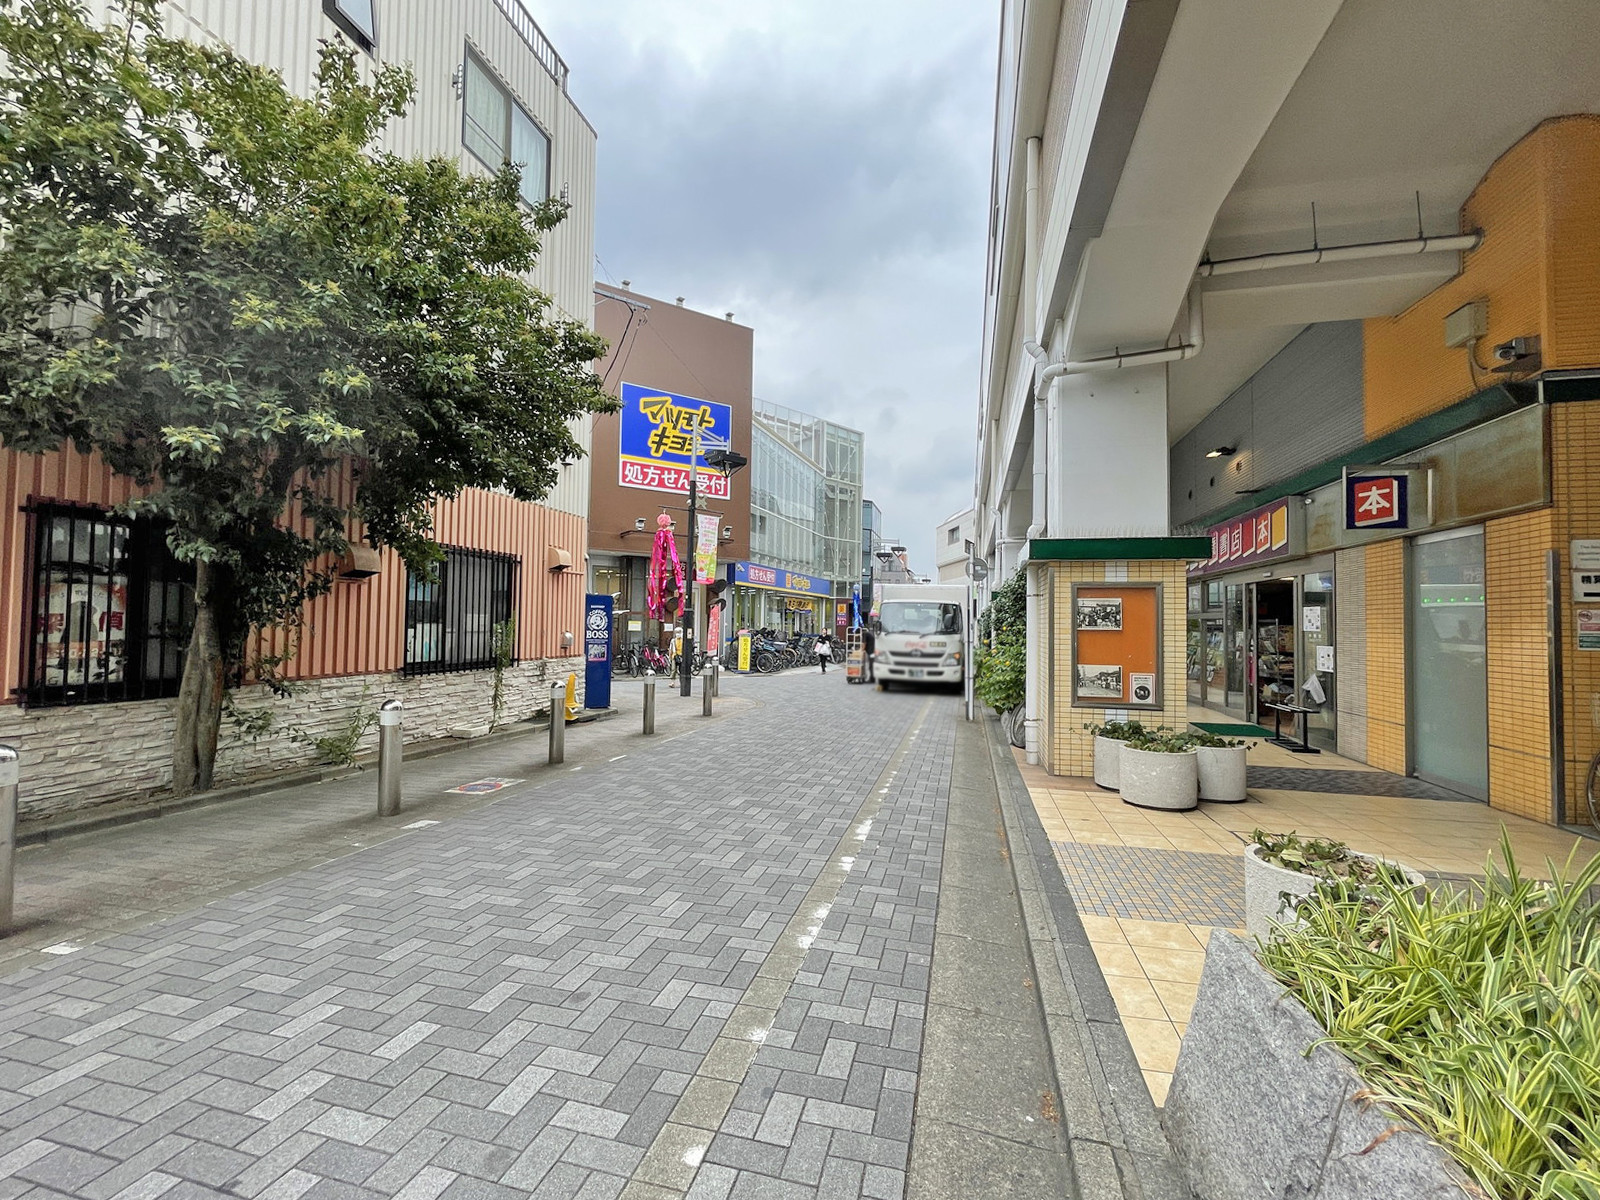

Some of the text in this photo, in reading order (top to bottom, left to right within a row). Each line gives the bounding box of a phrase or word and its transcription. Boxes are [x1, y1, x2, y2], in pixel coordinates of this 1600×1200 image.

[641, 398, 714, 432] マツモト
[624, 463, 727, 495] 処方せん受付
[1358, 485, 1390, 515] 本
[1257, 518, 1268, 543] 本
[586, 630, 608, 639] BOSS
